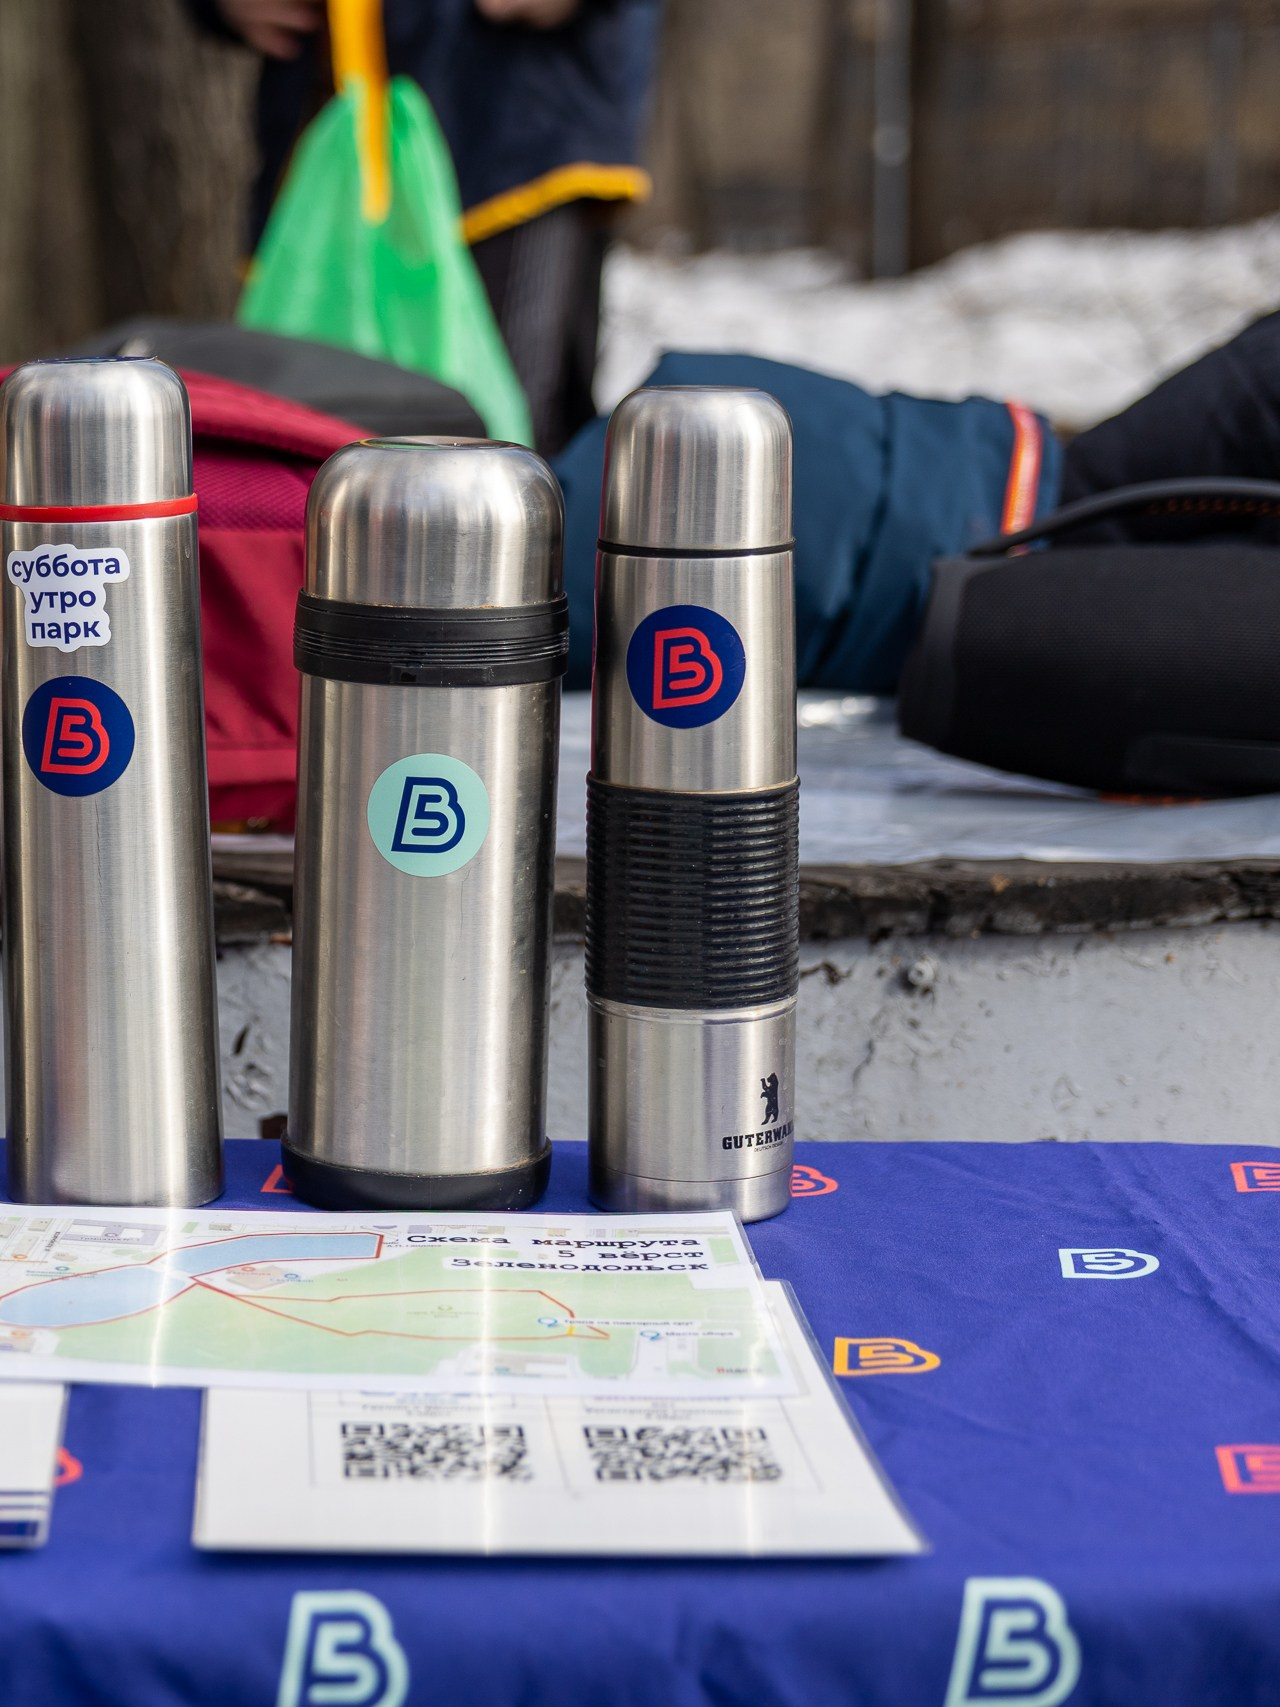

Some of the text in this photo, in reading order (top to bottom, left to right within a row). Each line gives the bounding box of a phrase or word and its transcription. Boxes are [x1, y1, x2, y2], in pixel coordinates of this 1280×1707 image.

[11, 553, 121, 583] суббота
[30, 590, 97, 614] утро
[31, 621, 101, 644] парк
[406, 1235, 700, 1249] Схема маршрута
[558, 1249, 705, 1261] 5 вёрст
[450, 1258, 710, 1272] Зеленодольск
